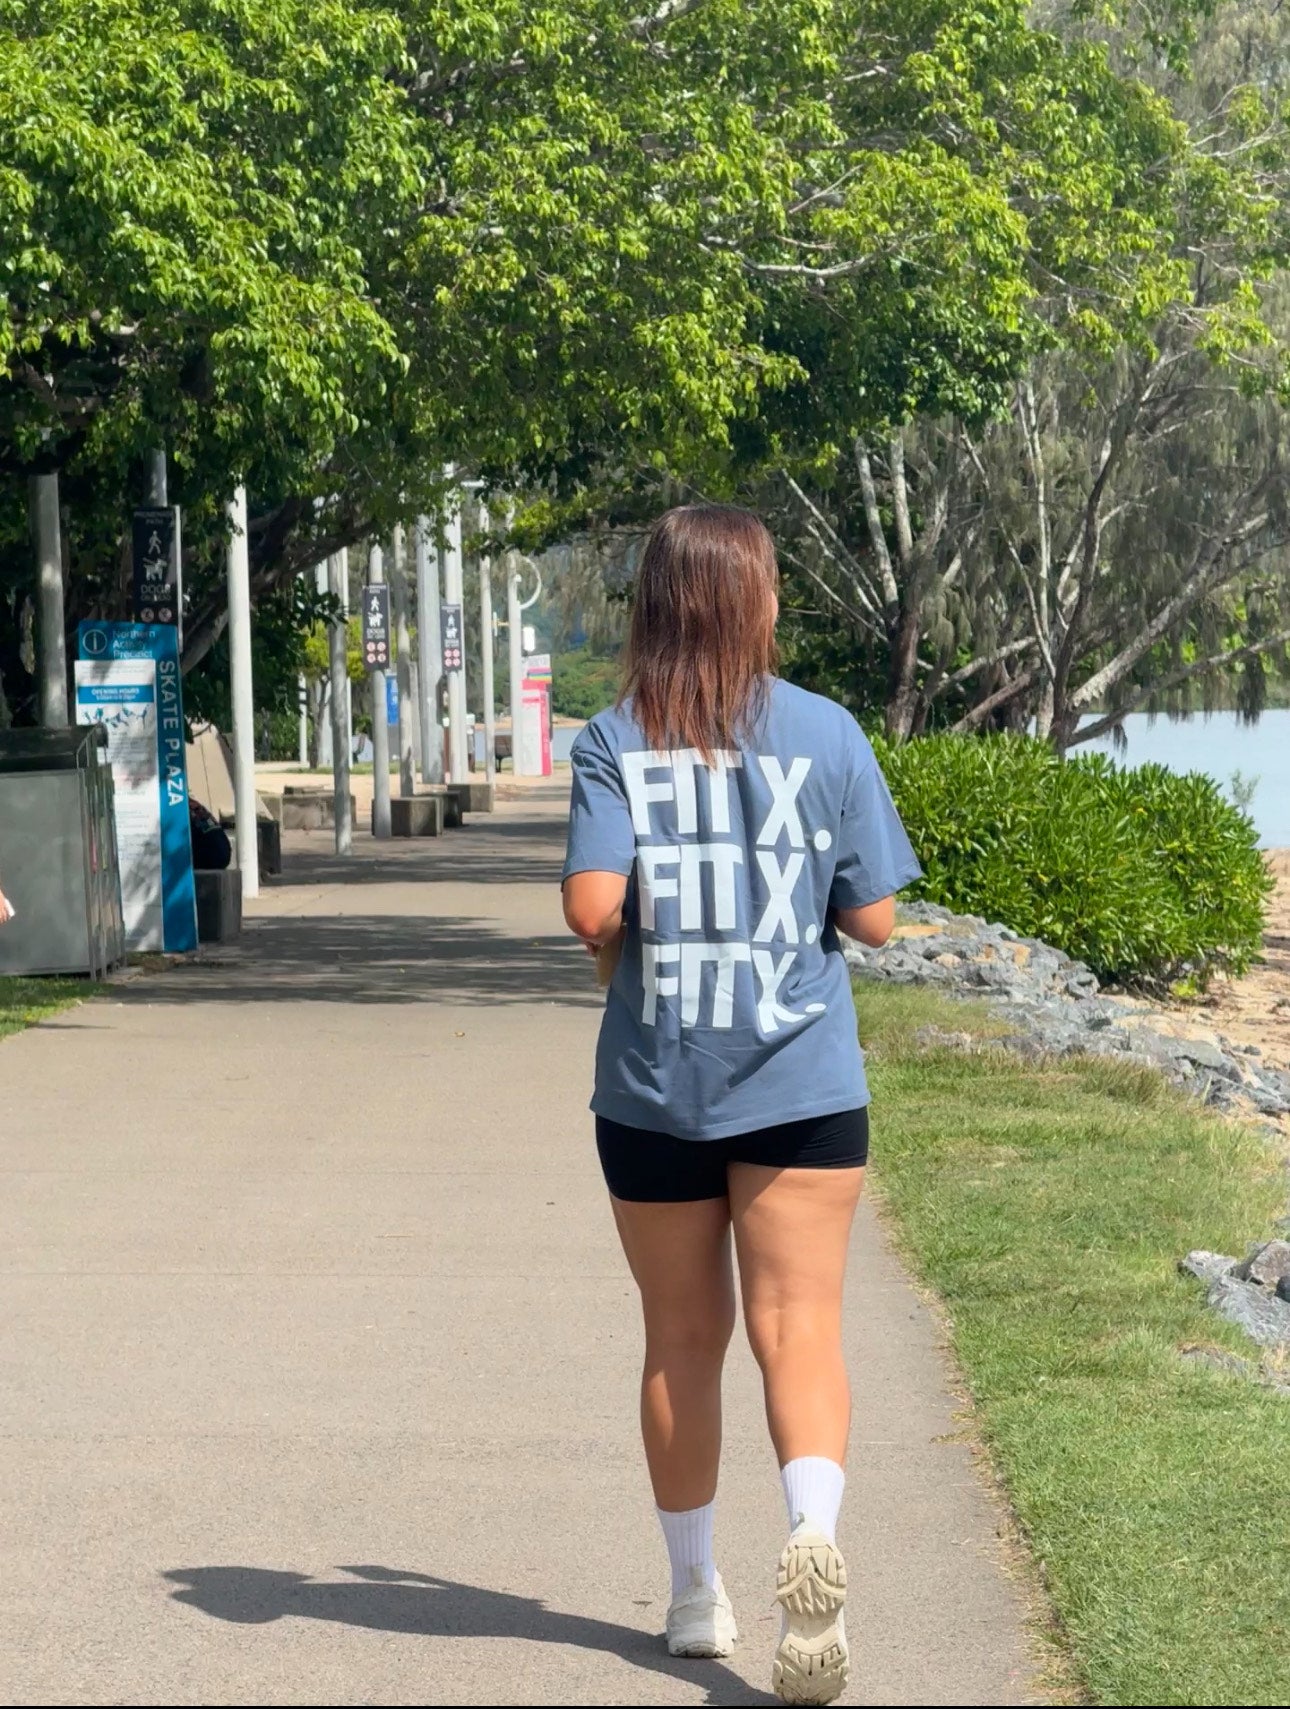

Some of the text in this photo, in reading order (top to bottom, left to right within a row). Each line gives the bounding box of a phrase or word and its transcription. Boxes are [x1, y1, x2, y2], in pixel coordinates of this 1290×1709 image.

[159, 660, 184, 806] SKATE PLAZA
[621, 748, 832, 851] FIT X.
[636, 843, 818, 945] FIT X.
[641, 942, 751, 1028] FIT
